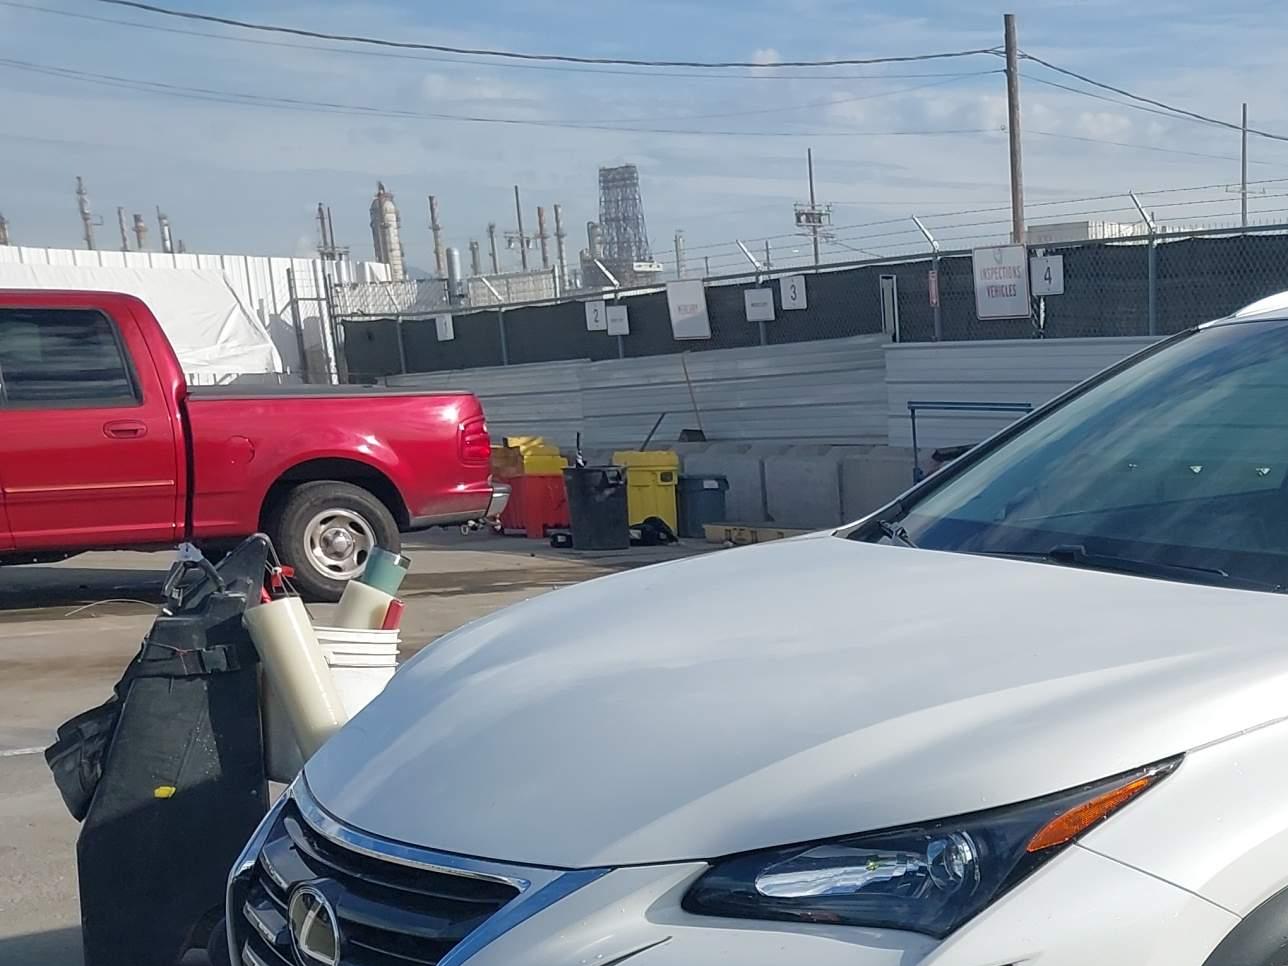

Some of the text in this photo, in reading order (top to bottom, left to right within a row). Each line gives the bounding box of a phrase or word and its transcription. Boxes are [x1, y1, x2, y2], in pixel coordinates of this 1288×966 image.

[979, 266, 1021, 281] INSPECTIONS
[1043, 267, 1052, 285] 4
[790, 284, 797, 301] 3
[986, 284, 1017, 298] VEHICLES
[592, 308, 600, 324] 2
